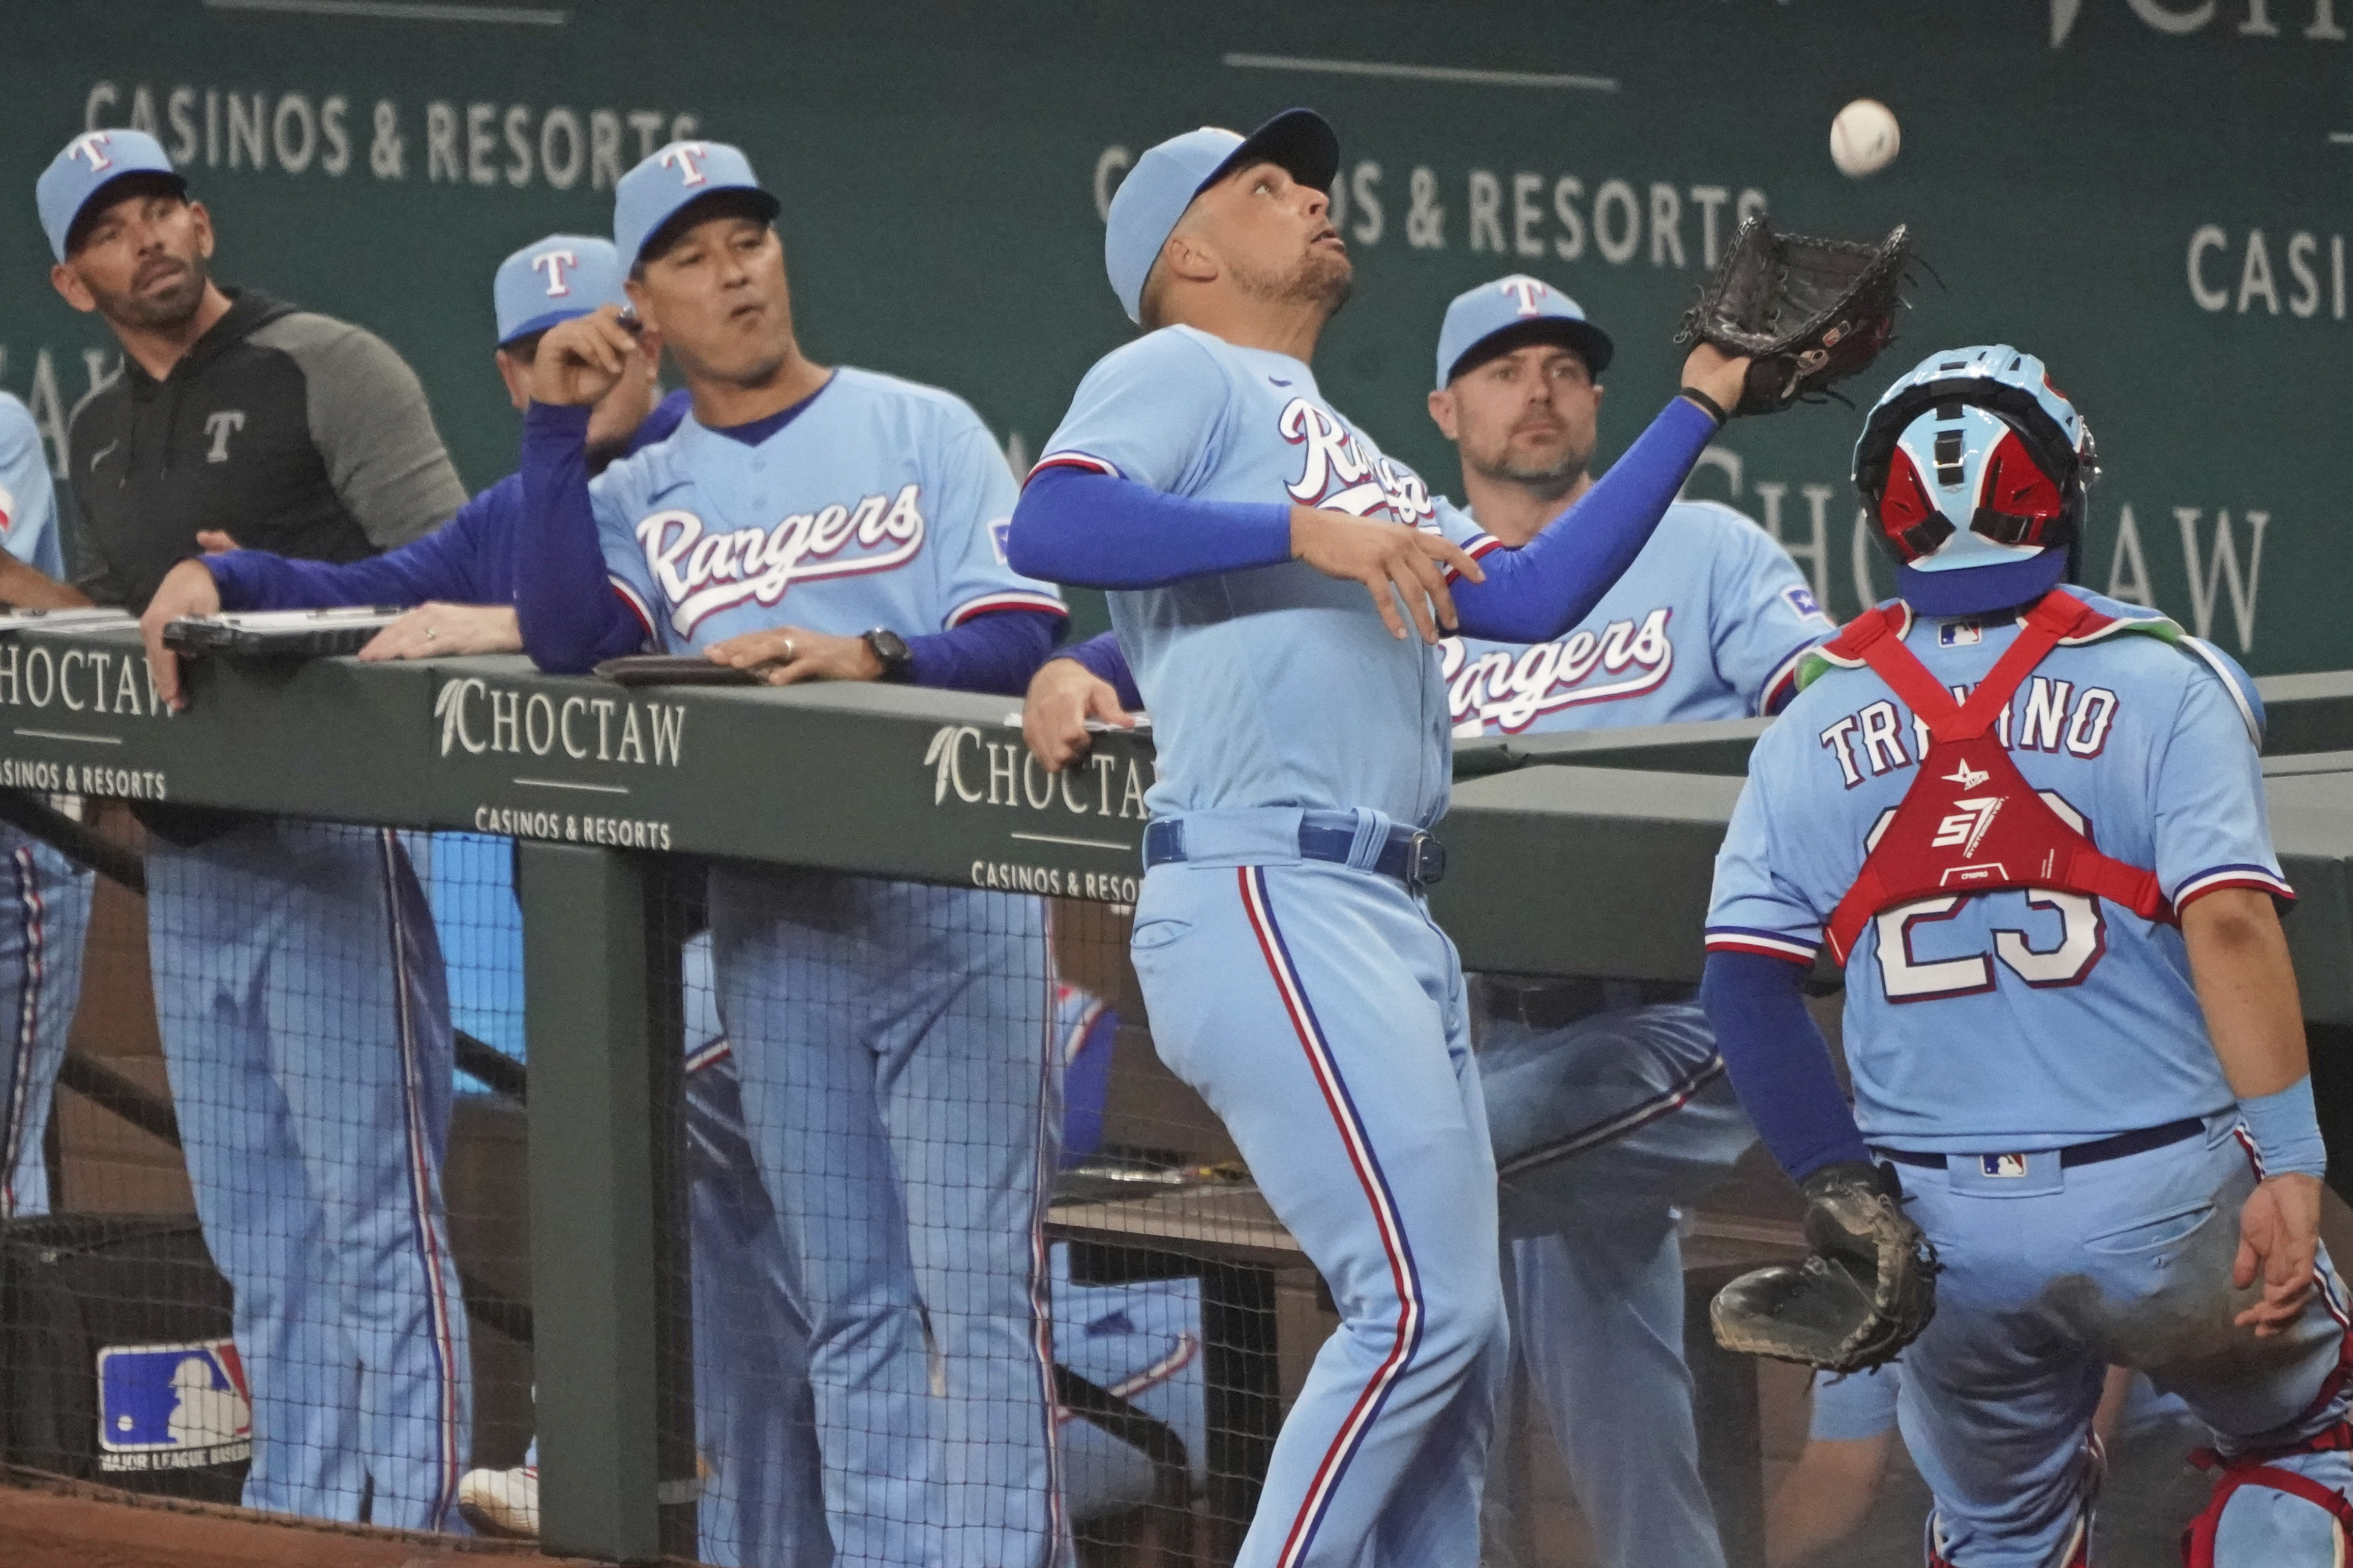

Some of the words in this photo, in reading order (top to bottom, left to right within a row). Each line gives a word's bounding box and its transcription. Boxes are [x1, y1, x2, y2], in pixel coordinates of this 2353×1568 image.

[69, 132, 112, 174] T
[85, 81, 351, 179] CASINOS
[370, 100, 405, 180] &
[661, 144, 707, 188] T
[1406, 167, 1447, 251] &
[532, 250, 579, 298] T
[1501, 279, 1548, 319] T
[2187, 224, 2346, 321] CASI
[204, 409, 246, 464] T
[635, 483, 925, 630] Rangers
[457, 677, 686, 766] CHOCTAW
[0, 757, 59, 791] SINOS
[65, 764, 77, 792] &
[82, 765, 167, 801] RESORTS
[951, 726, 1159, 820] CHOCTA
[474, 805, 560, 840] CASINOS
[565, 814, 579, 842] &
[583, 815, 672, 851] RESORTS
[971, 859, 1062, 895] CASINOS
[1067, 871, 1081, 899] &
[1084, 872, 1144, 903] RESO
[1864, 788, 2108, 1004] 23
